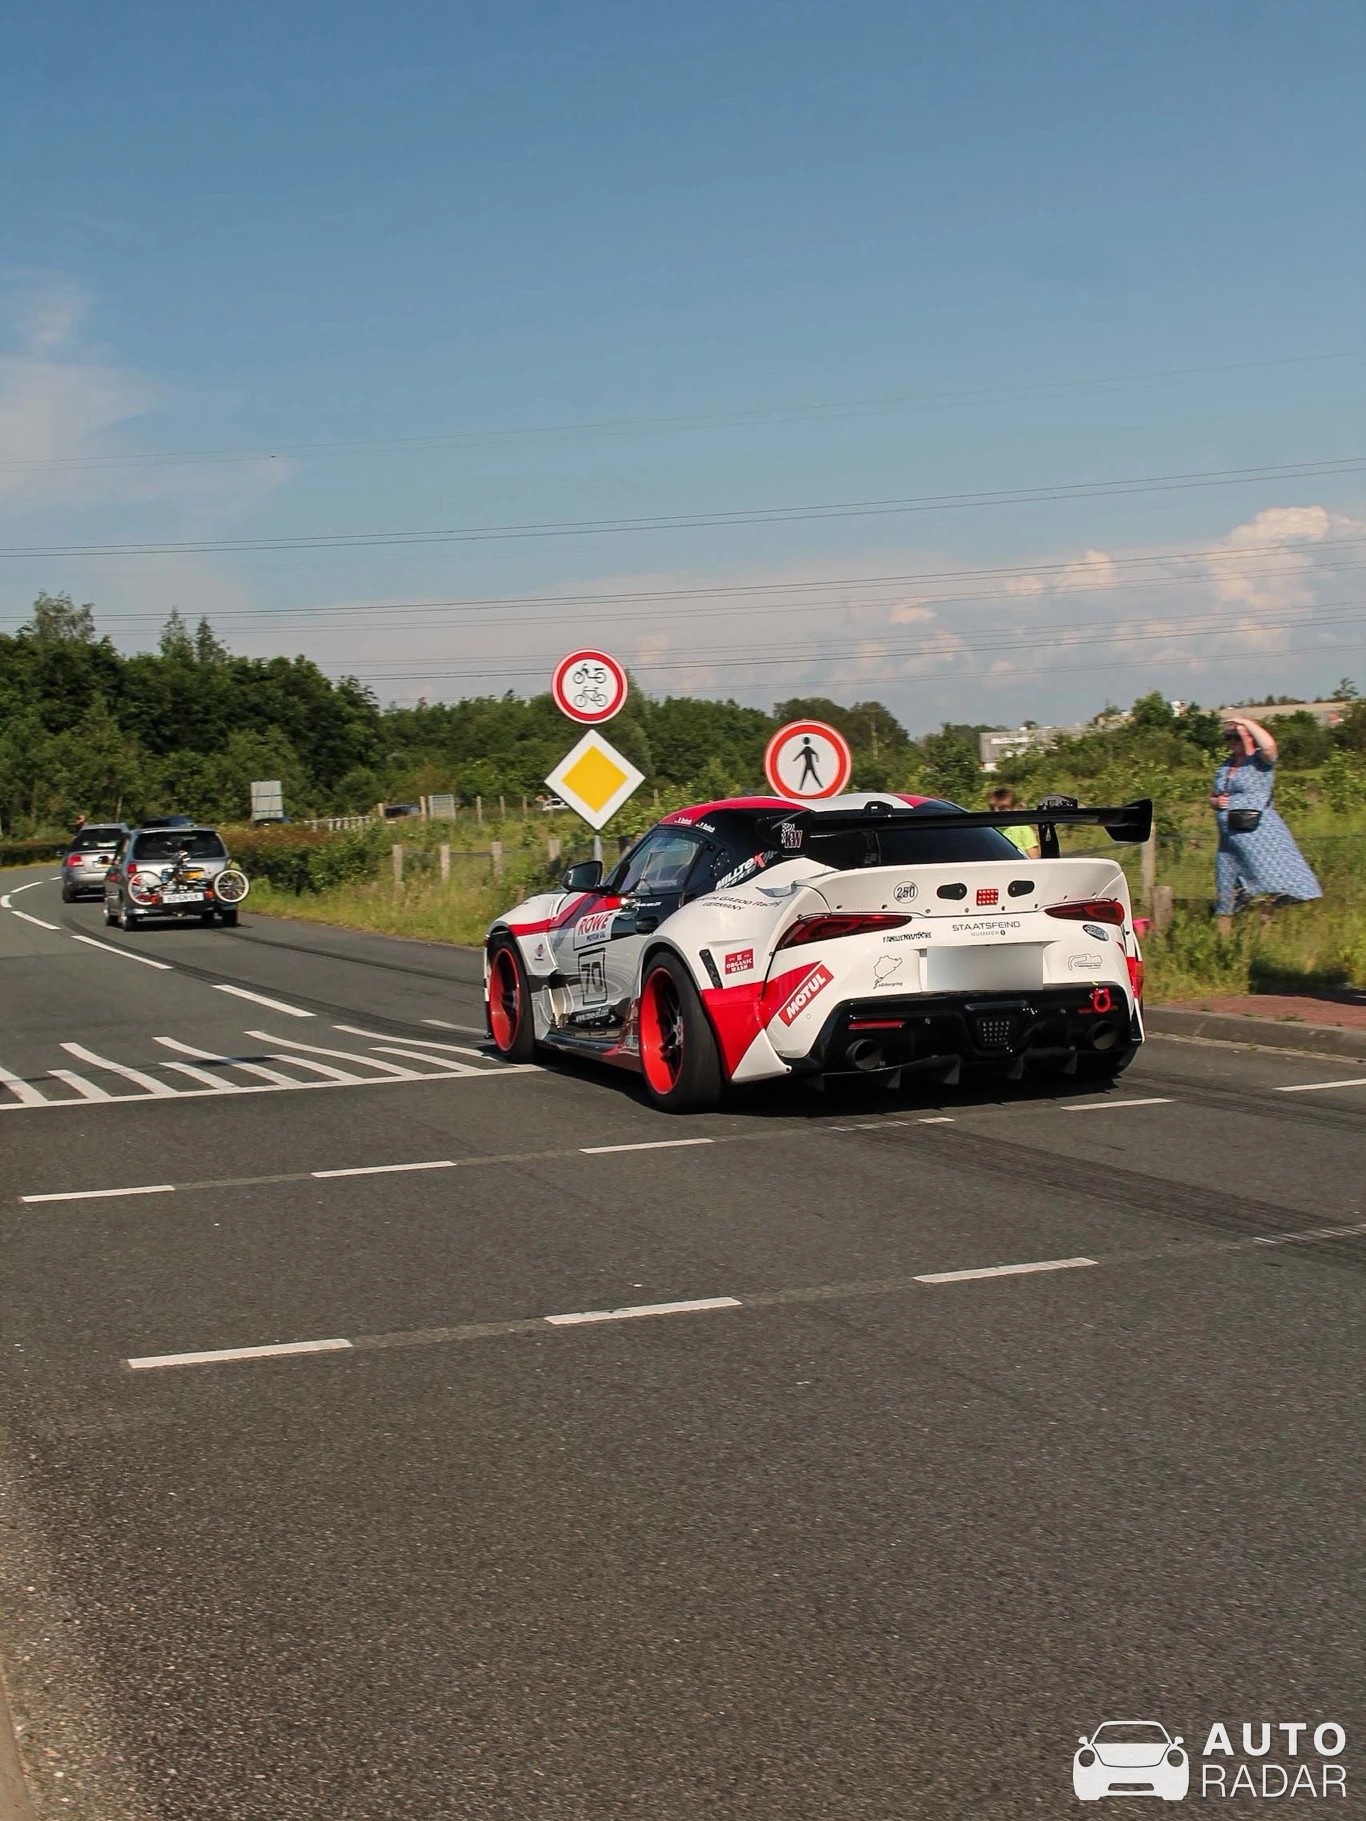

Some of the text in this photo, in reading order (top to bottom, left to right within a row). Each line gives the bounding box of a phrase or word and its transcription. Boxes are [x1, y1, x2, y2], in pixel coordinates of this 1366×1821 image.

[702, 901, 745, 911] GERMANY
[578, 914, 609, 935] ROWE
[952, 920, 1021, 931] STAATSFEIND
[726, 957, 753, 969] ORGANIC
[731, 964, 749, 972] WASH
[786, 973, 827, 1020] MOTUL
